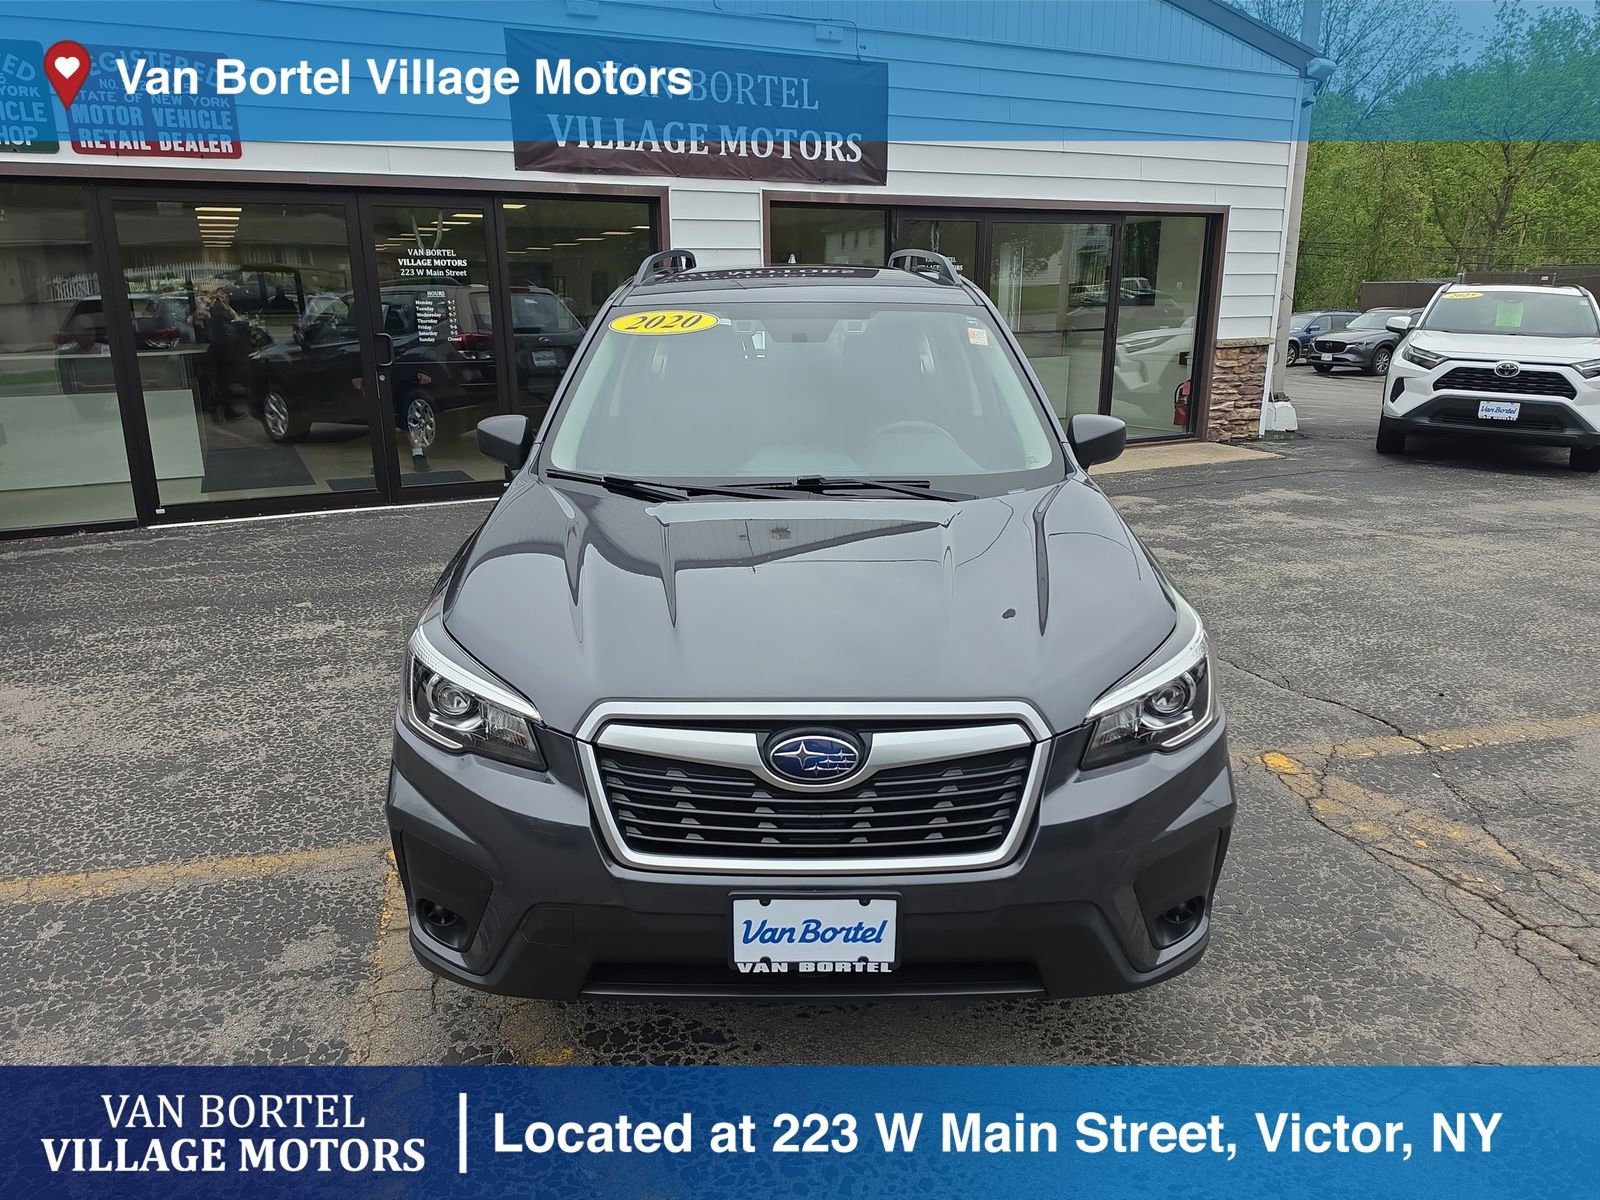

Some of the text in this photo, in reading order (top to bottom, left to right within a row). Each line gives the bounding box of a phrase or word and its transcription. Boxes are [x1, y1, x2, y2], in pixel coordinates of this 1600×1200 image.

[76, 90, 231, 108] TATE OF NEW YORK
[688, 68, 819, 110] BORTEL
[0, 100, 48, 122] ICLE
[71, 103, 234, 130] MOTOR VEHICLE
[0, 124, 39, 146] HOP
[78, 128, 234, 154] RETAIL DEALER
[546, 113, 863, 163] VILLAGE MOTORS
[398, 258, 468, 267] VILLAGE MOTORS
[407, 248, 457, 257] VAN BORTEL
[400, 268, 415, 276] 223
[624, 314, 703, 330] 2020
[742, 918, 888, 944] Van Bortel
[736, 961, 893, 973] VAN BORTEL
